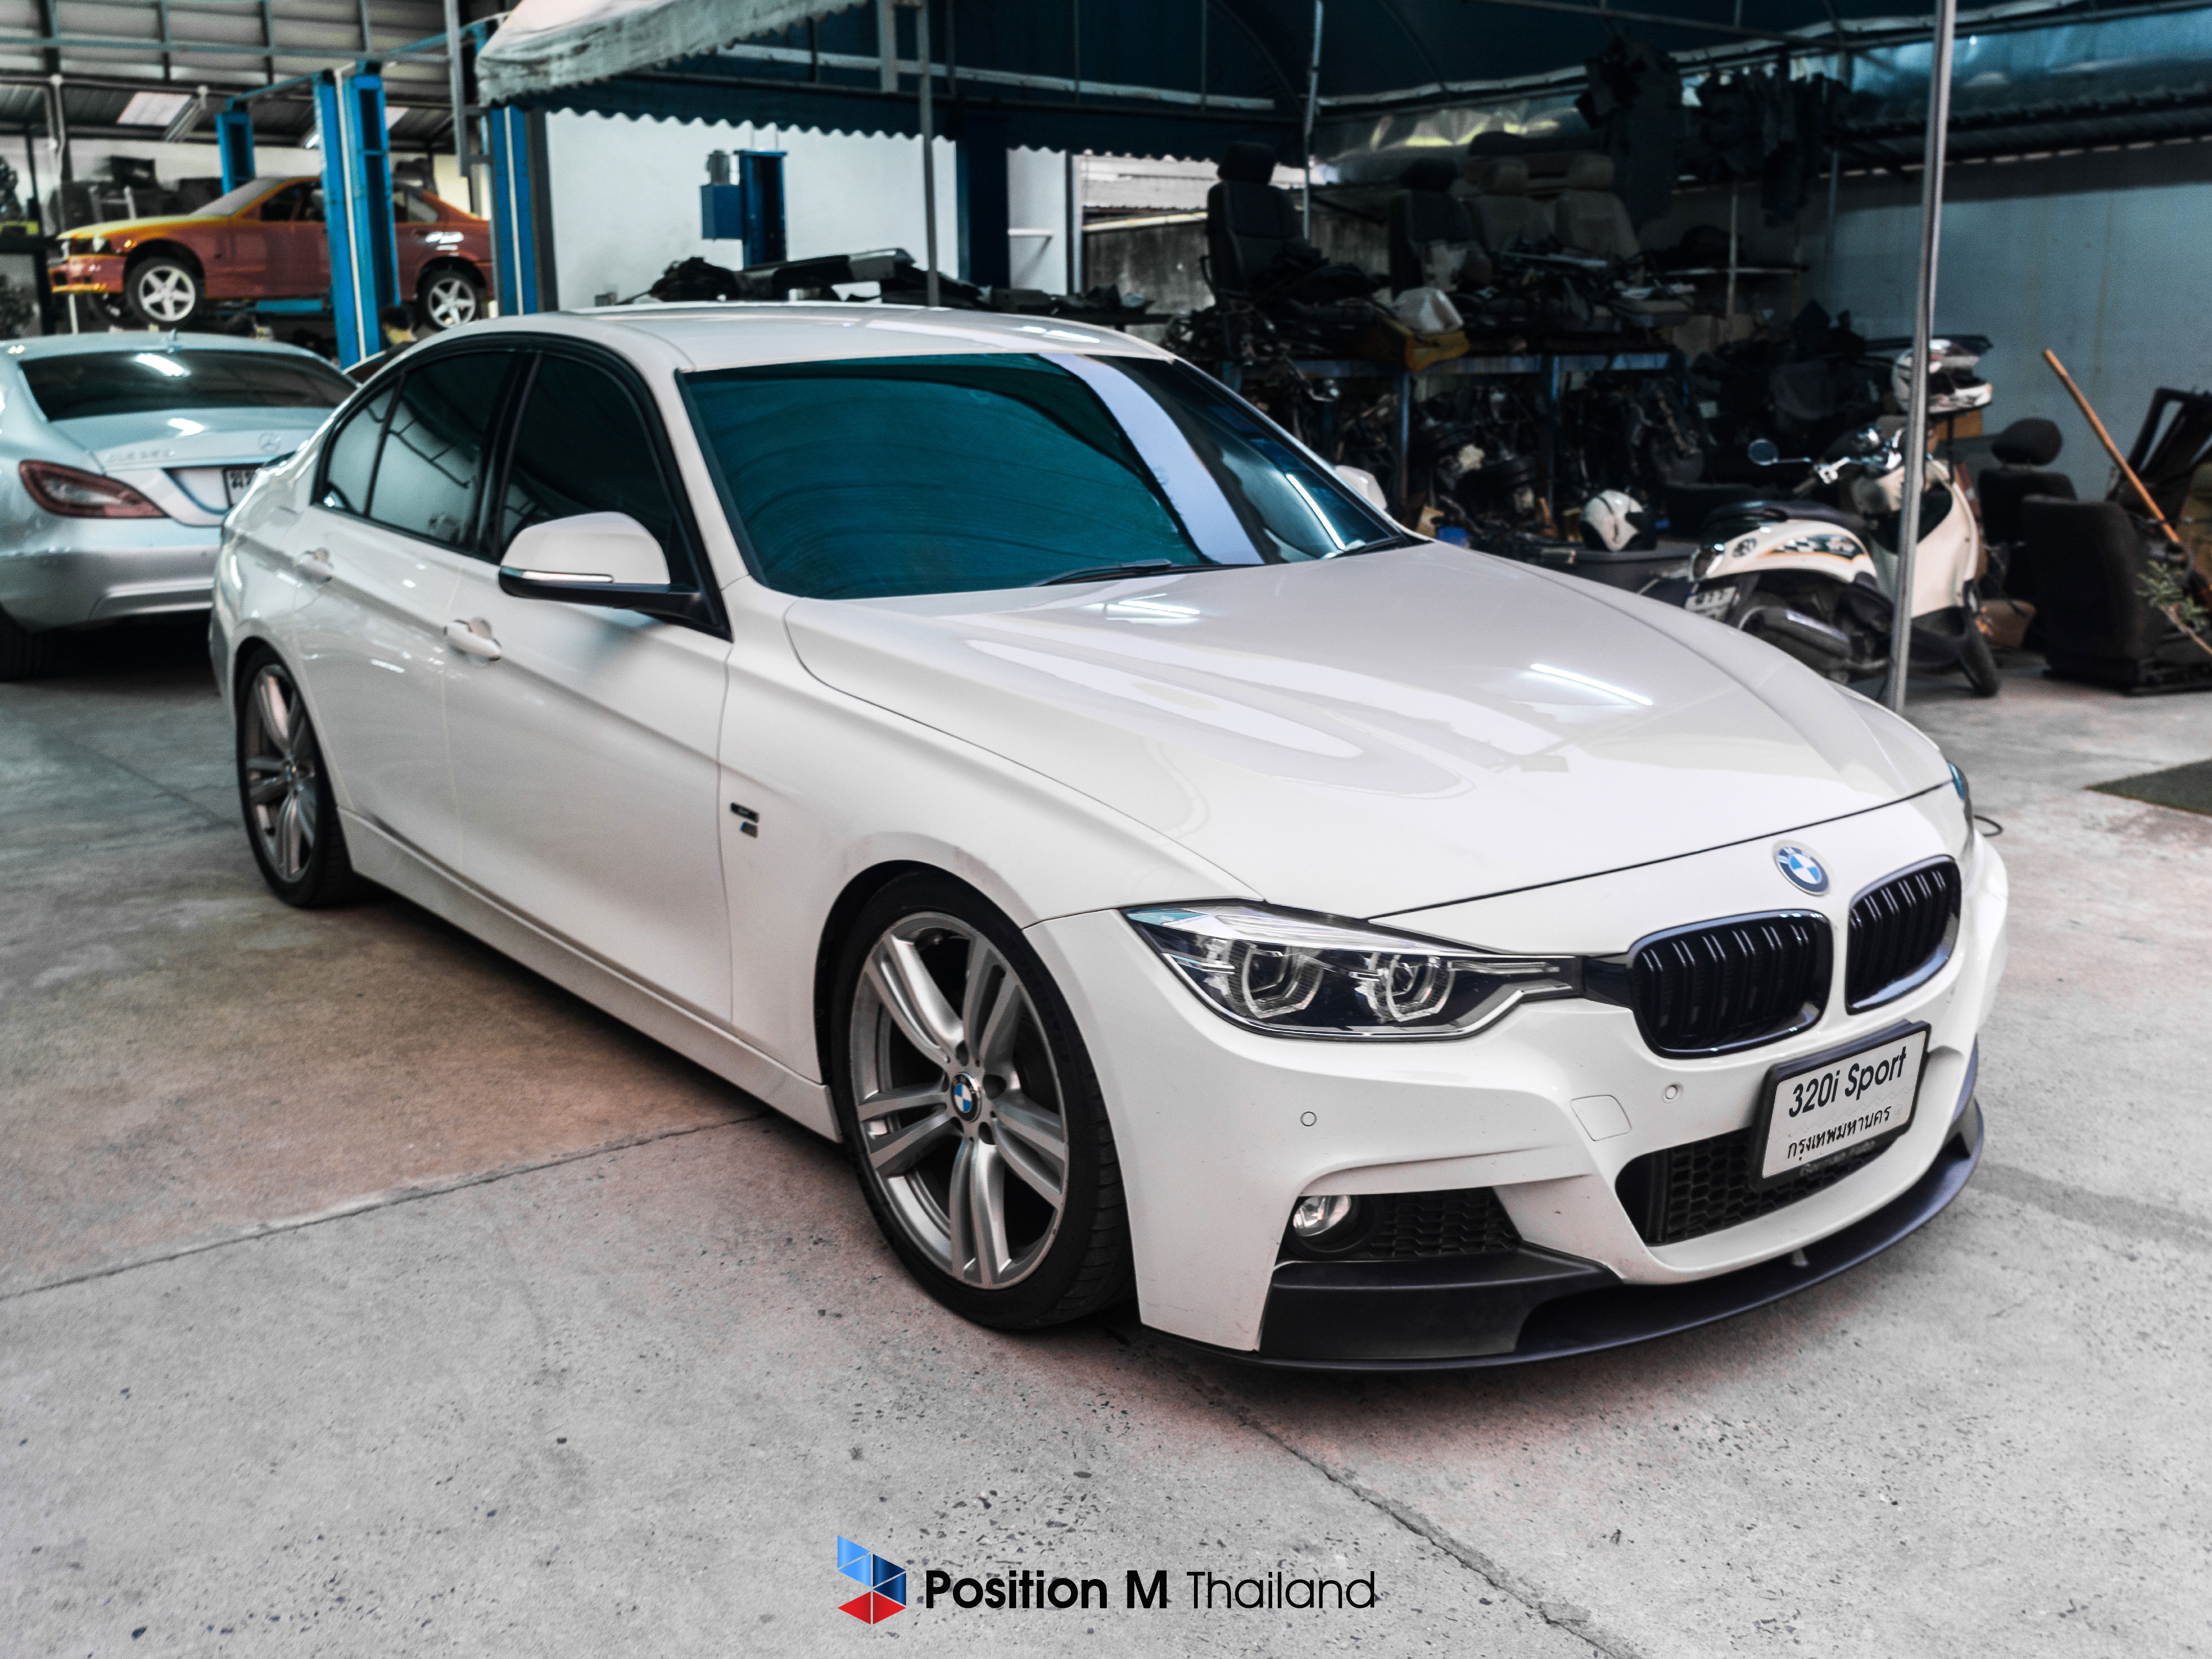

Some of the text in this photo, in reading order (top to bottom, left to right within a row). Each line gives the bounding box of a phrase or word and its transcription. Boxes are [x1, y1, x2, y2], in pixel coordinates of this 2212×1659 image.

[1788, 1046, 1906, 1117] 320i Sport
[1787, 1105, 1891, 1161] กรุงเทพมหานคร
